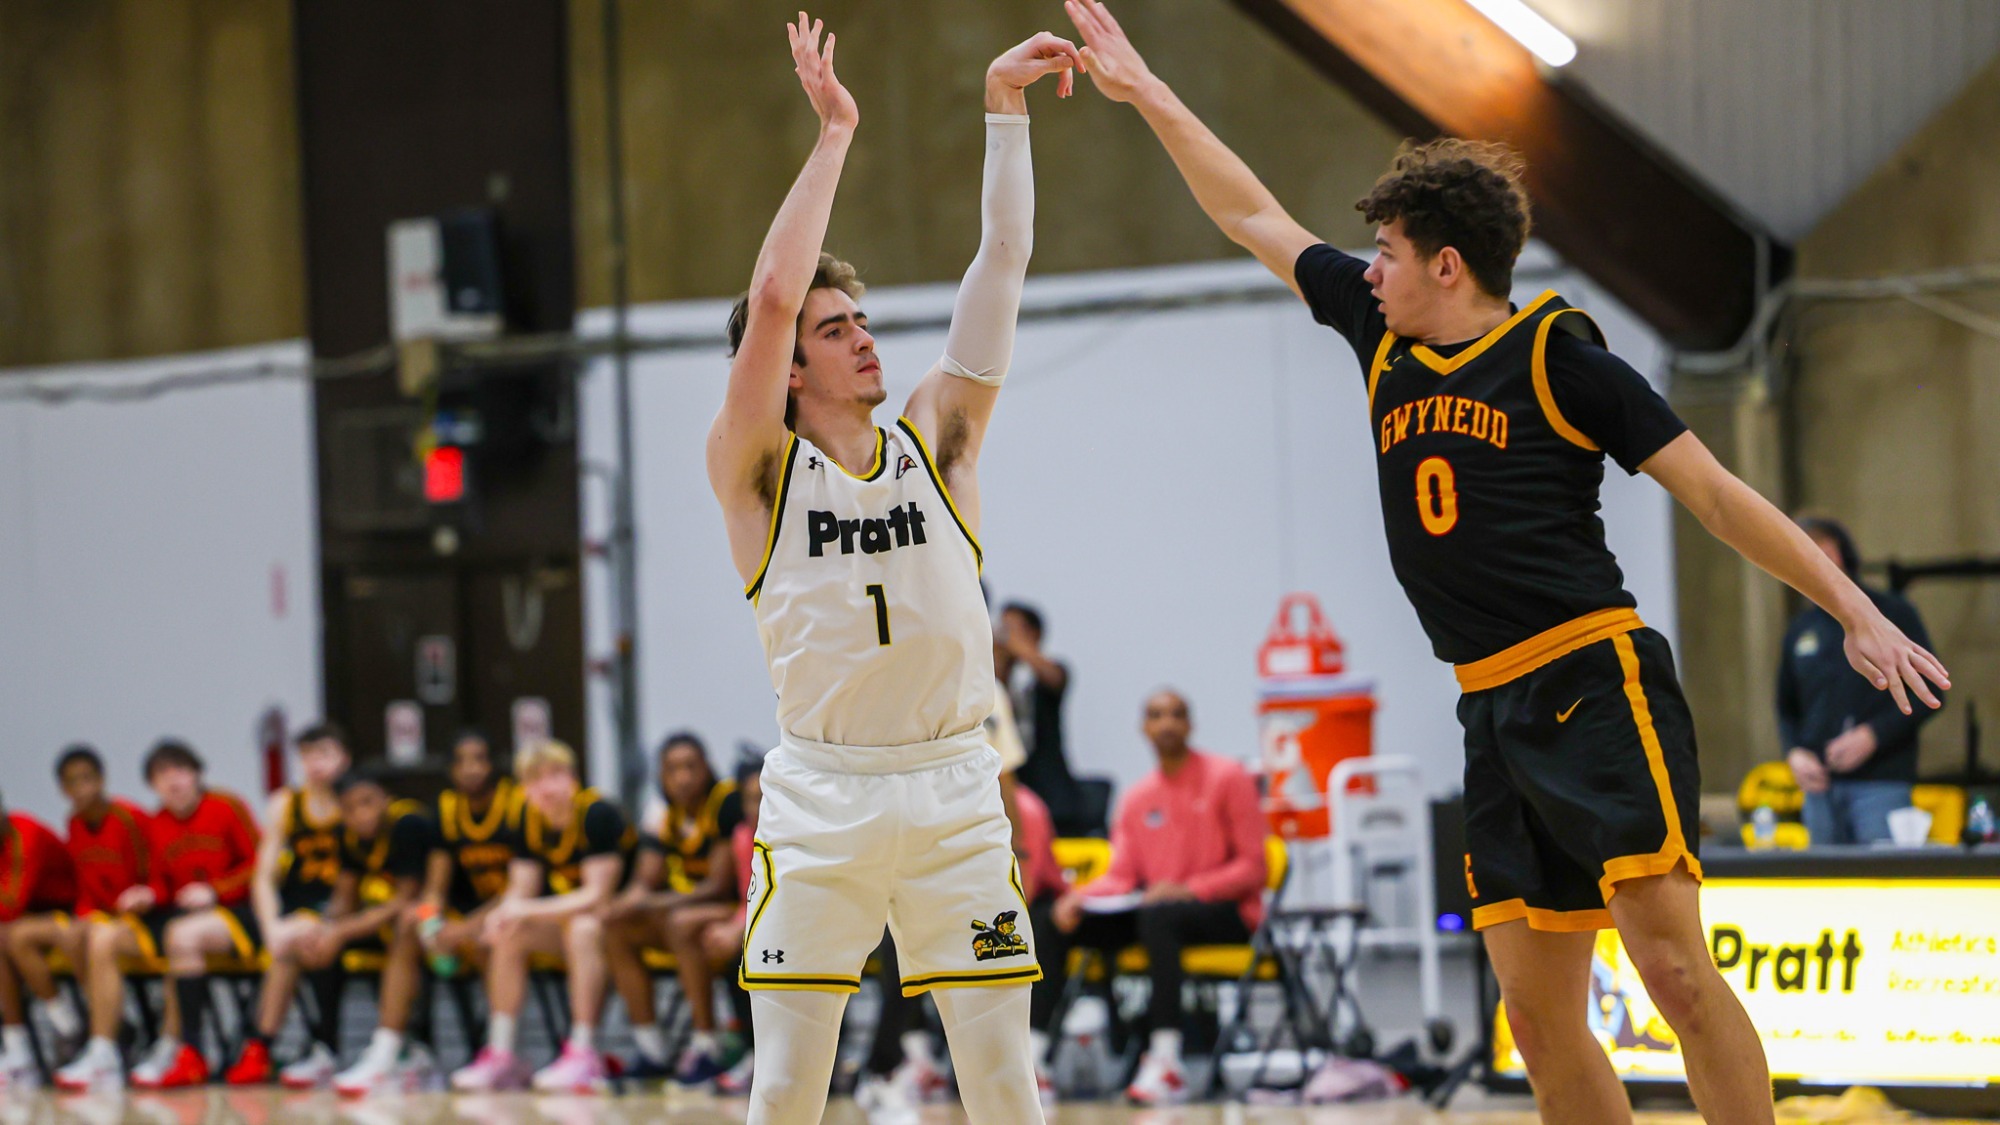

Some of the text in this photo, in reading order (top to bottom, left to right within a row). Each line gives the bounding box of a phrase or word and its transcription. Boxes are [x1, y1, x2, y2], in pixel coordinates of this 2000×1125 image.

[1380, 395, 1510, 454] GWYNEDD
[1415, 455, 1460, 536] 0
[807, 501, 927, 558] Pratt
[865, 583, 891, 646] 1
[1712, 927, 1862, 992] Pratt
